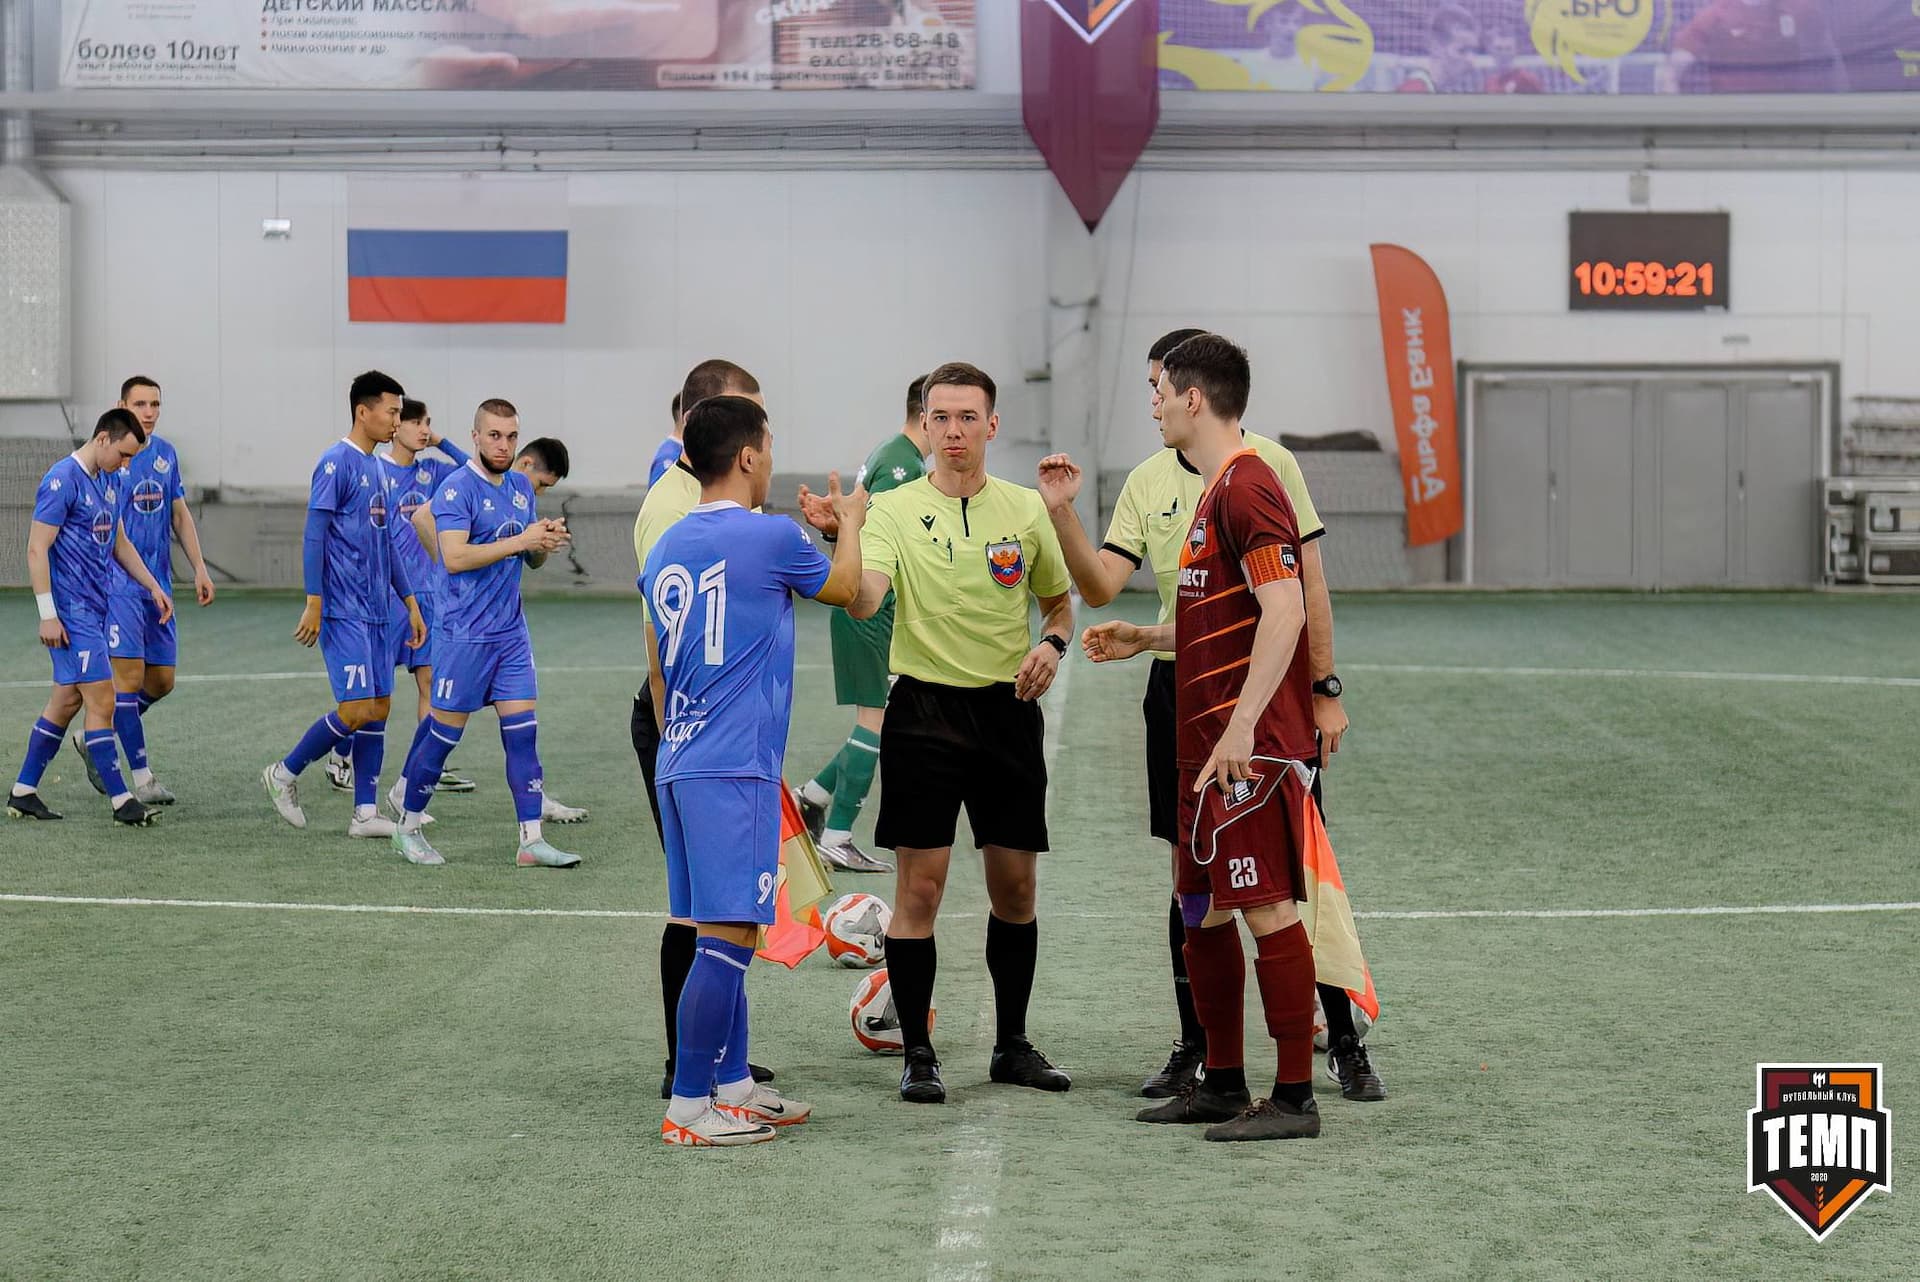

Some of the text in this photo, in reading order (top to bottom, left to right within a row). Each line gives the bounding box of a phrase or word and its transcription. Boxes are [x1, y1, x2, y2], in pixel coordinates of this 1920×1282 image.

[78, 38, 156, 60] более
[1574, 261, 1714, 296] 10:59:21
[1401, 306, 1435, 389] Банк
[653, 559, 727, 667] 91
[109, 624, 120, 649] 5
[78, 651, 91, 673] 7
[344, 664, 367, 690] 71
[437, 678, 453, 699] 11
[1228, 856, 1259, 889] 23
